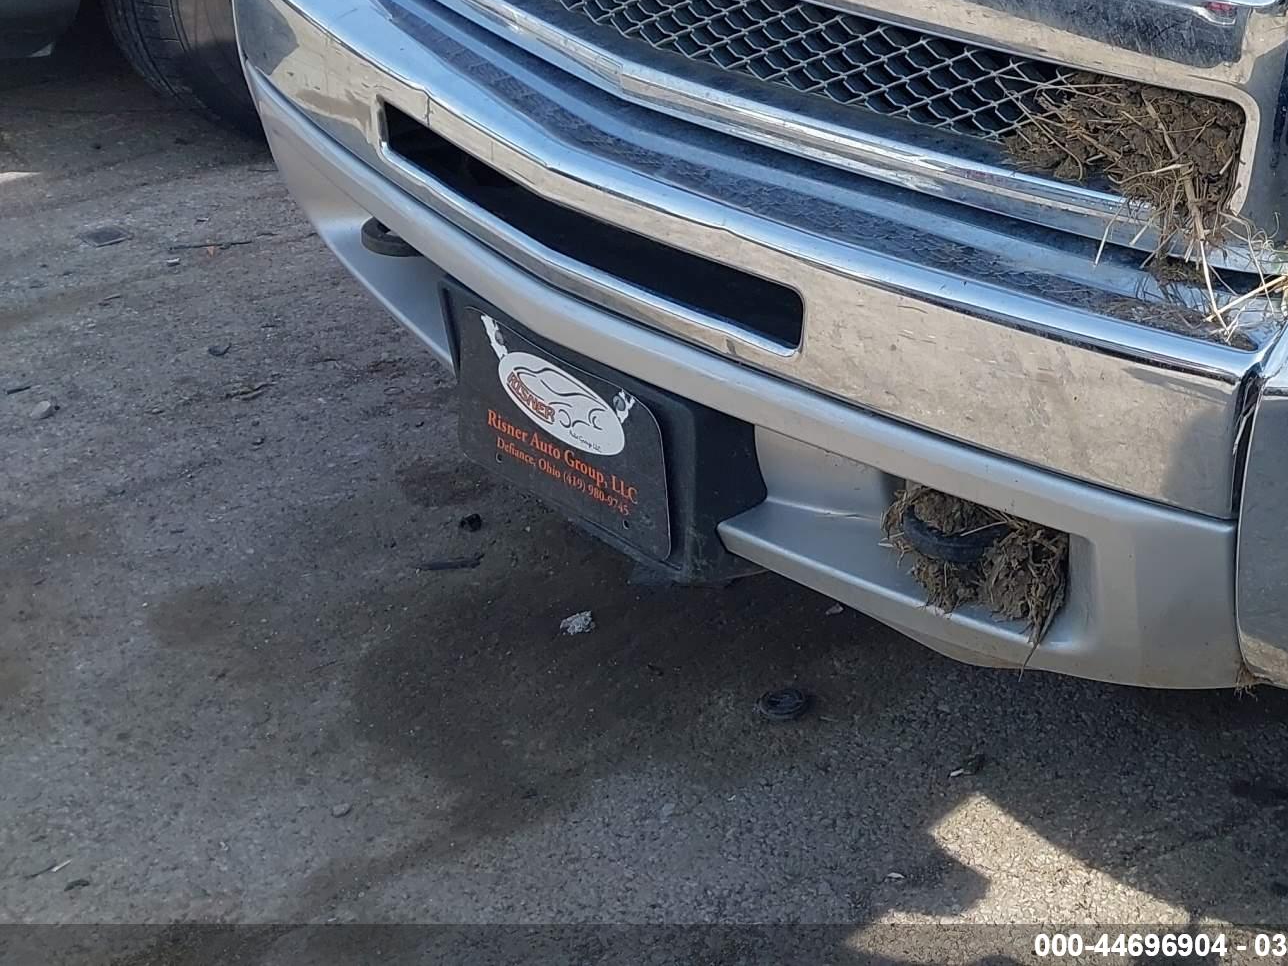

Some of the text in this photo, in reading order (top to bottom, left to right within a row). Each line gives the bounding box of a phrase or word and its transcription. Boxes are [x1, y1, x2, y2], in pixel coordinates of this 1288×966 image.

[506, 371, 556, 423] RISNER
[487, 409, 639, 505] Risner Auto Group, LLC
[496, 437, 629, 516] Defiance, Ohio (419) 980-9745
